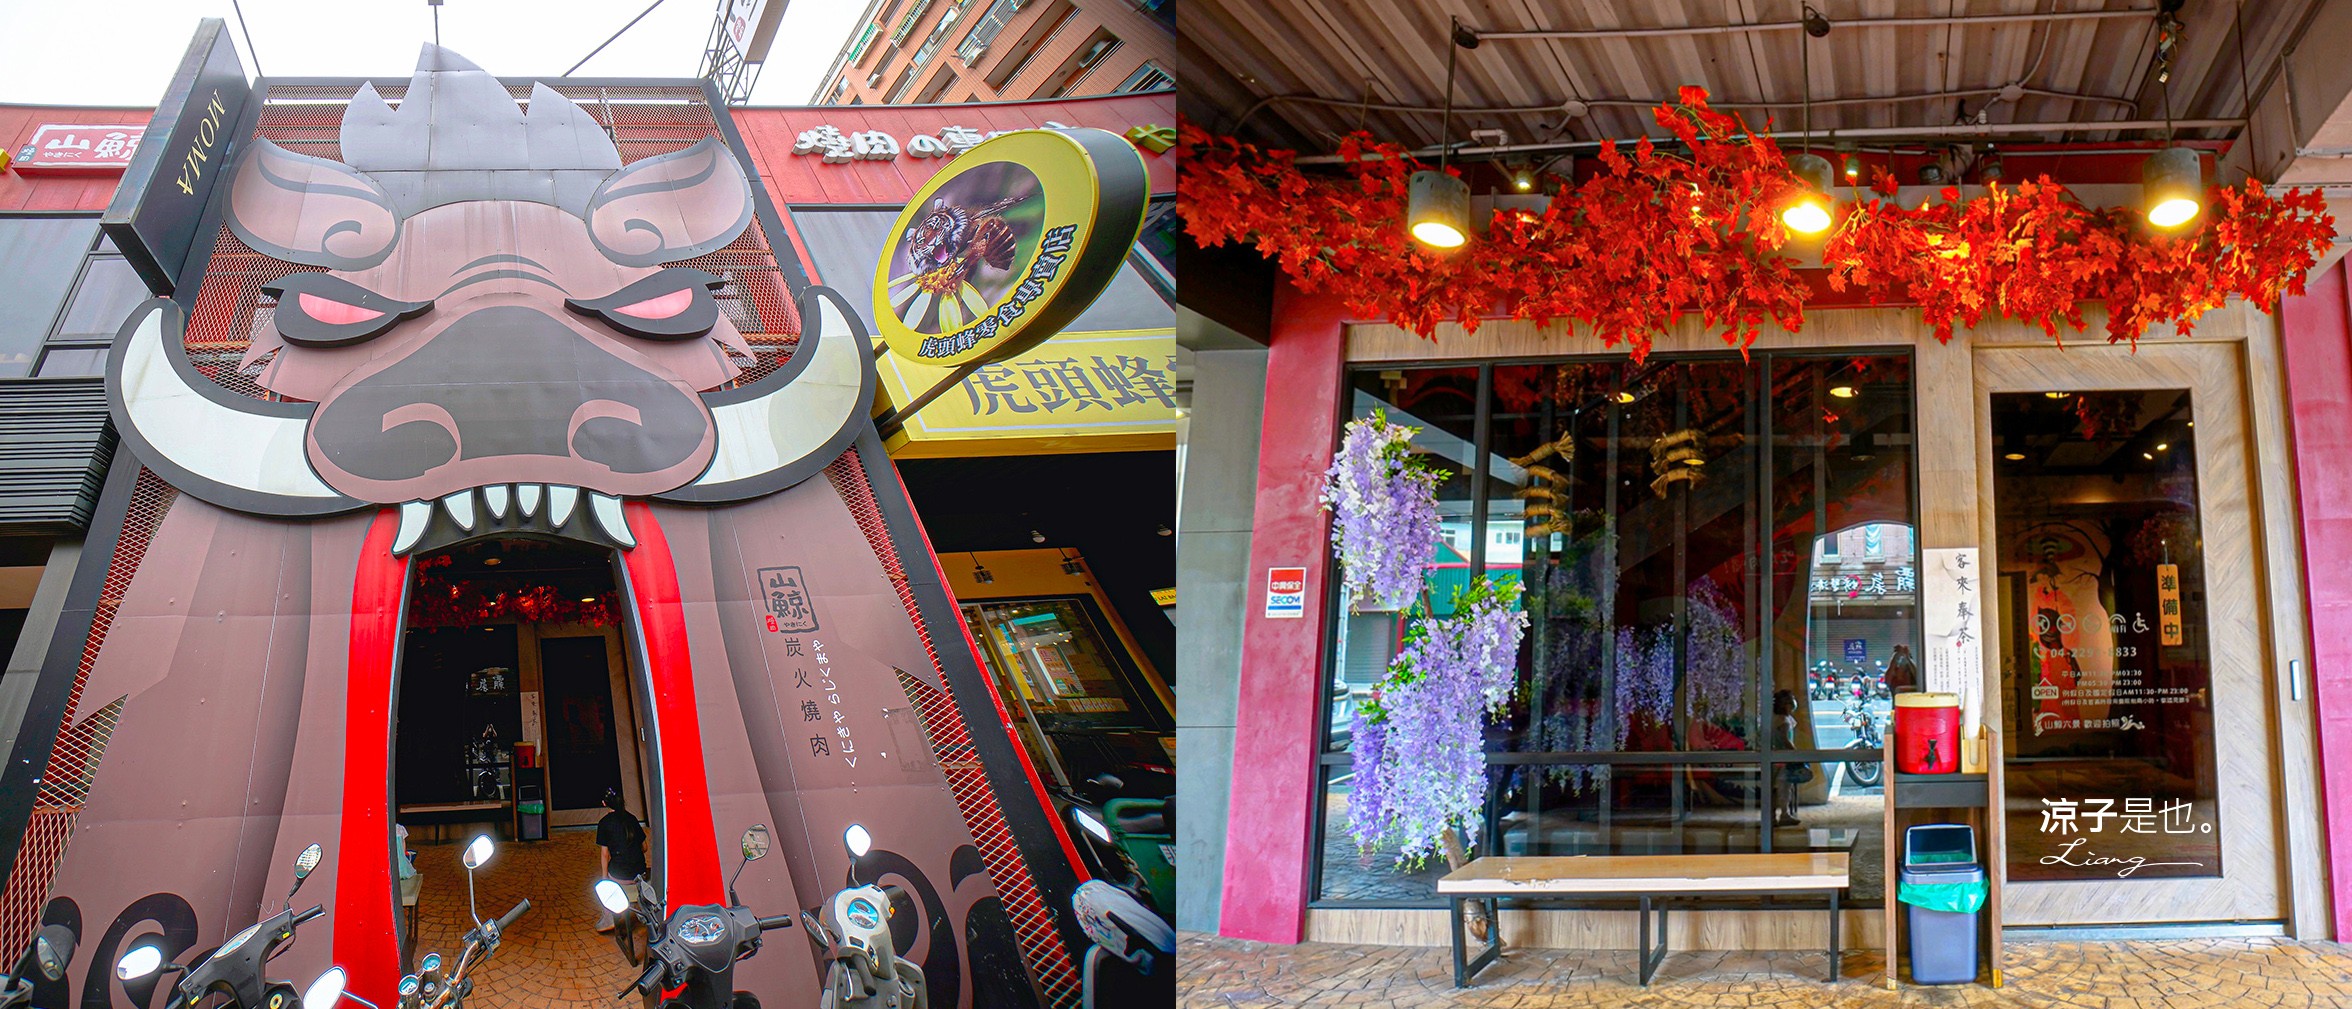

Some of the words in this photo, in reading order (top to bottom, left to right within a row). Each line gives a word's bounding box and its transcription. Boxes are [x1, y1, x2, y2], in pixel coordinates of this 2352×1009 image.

[176, 88, 226, 196] MOMA
[961, 354, 1176, 416] 虎頭蜂
[769, 572, 810, 619] 山鯨
[1270, 595, 1301, 605] SECOM
[1955, 552, 1975, 644] 客來奉茶
[2161, 574, 2179, 639] 準備中
[785, 637, 831, 758] 炭火燒肉
[2033, 689, 2057, 697] OPEN
